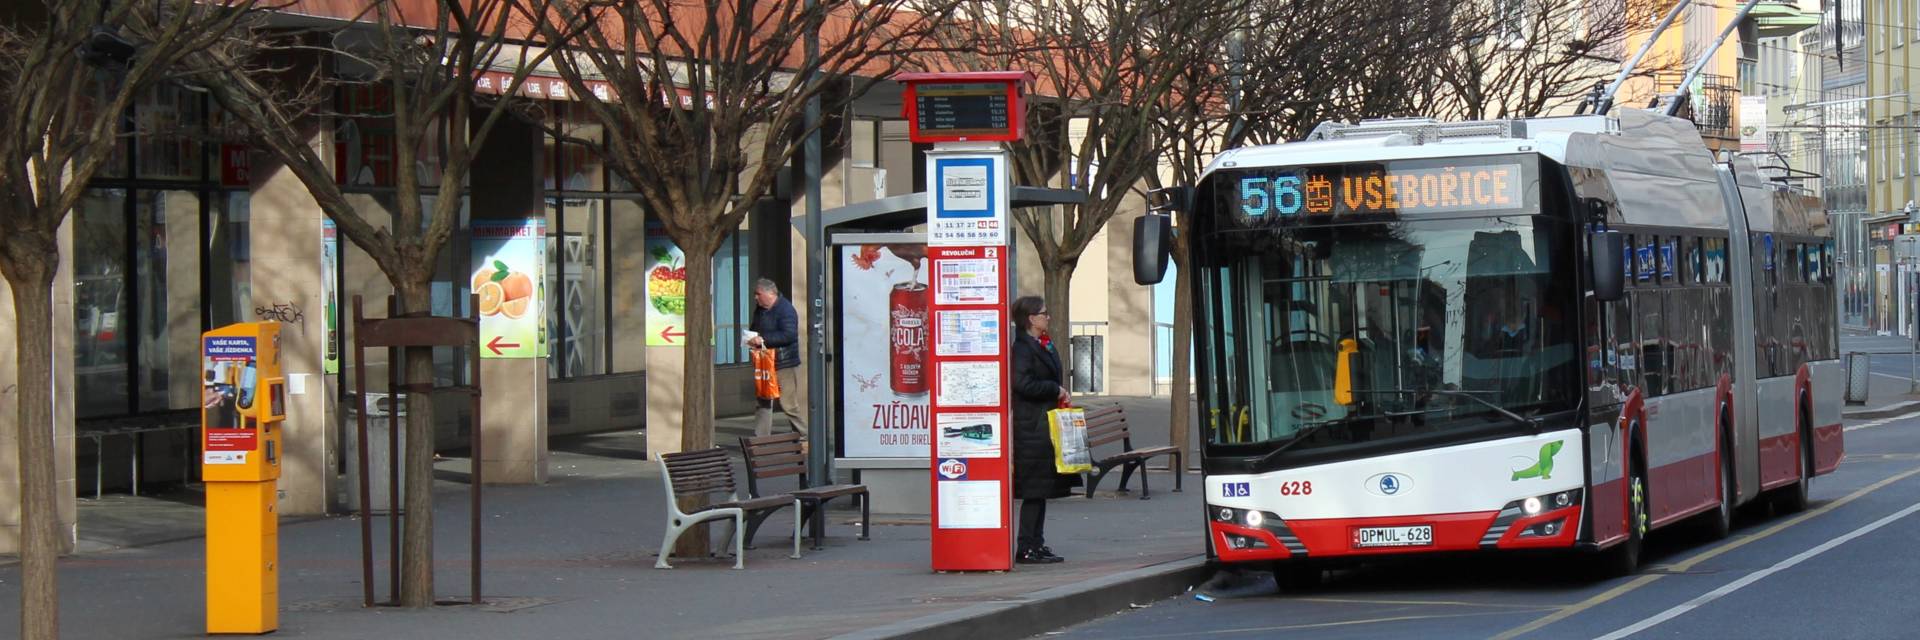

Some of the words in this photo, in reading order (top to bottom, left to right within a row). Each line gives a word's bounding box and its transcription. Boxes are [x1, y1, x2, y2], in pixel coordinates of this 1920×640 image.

[1240, 175, 1301, 216] 56
[1343, 166, 1509, 210] VŠEBOŘICE
[474, 227, 531, 237] MINIMARKET
[941, 248, 975, 256] REVOLUČNÍ
[896, 327, 925, 346] COLA
[880, 434, 897, 445] COLA
[900, 434, 910, 445] OD
[1280, 481, 1313, 496] 628
